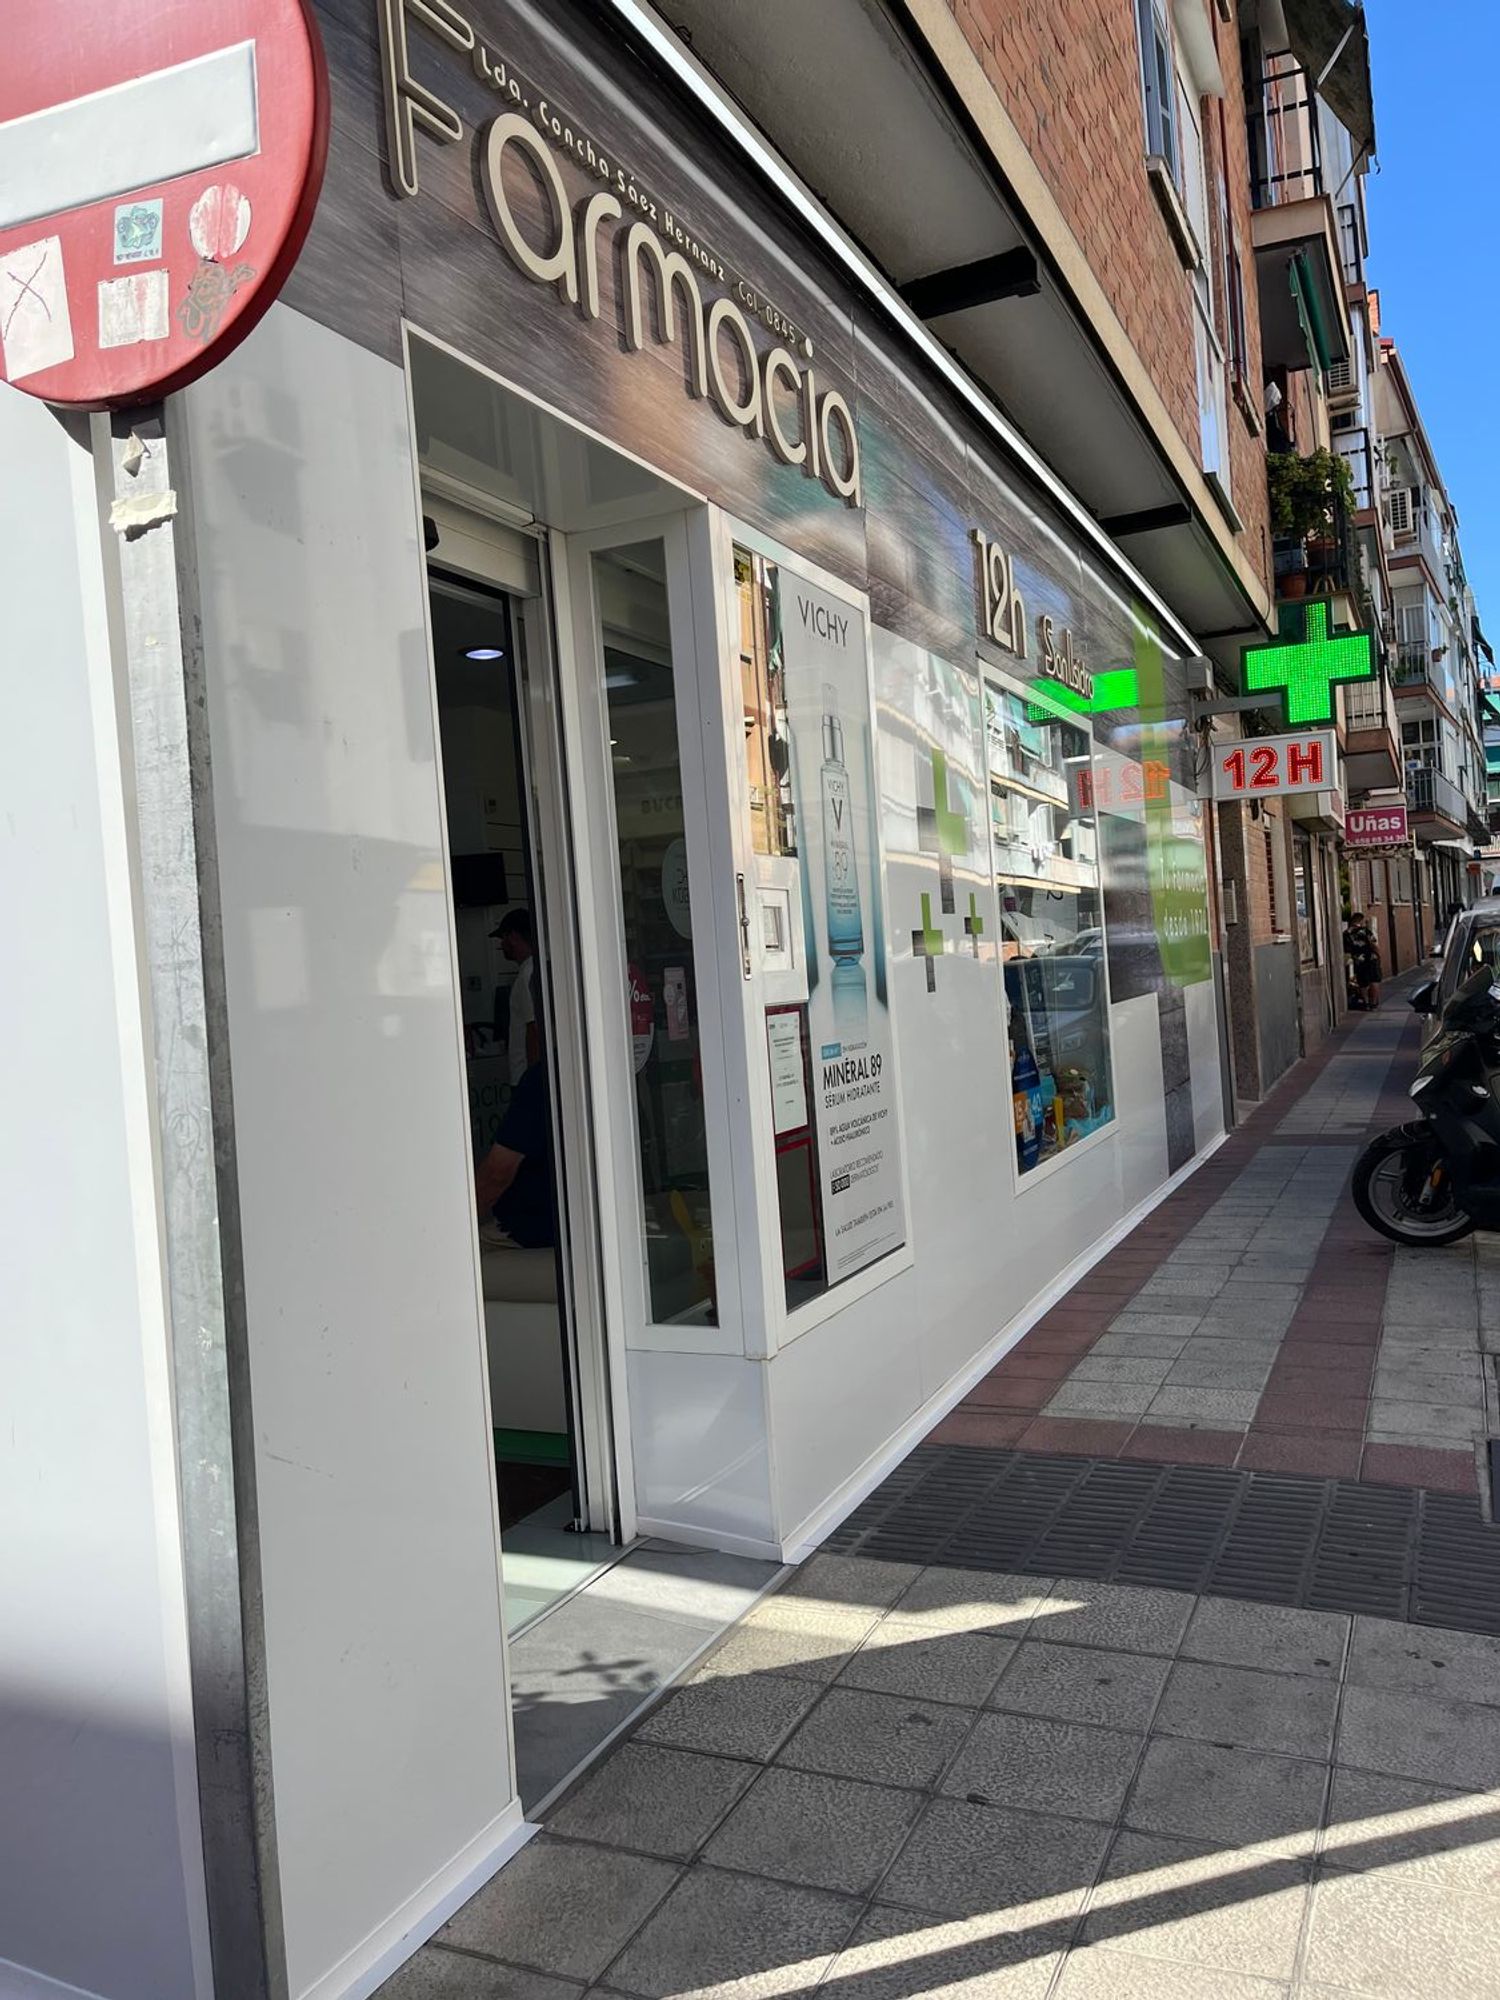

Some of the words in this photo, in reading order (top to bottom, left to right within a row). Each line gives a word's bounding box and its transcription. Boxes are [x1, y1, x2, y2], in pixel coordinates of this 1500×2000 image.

[481, 46, 528, 108] Lda.
[539, 101, 609, 178] Concha
[617, 170, 657, 221] Sáez
[665, 212, 725, 282] Hernanz
[738, 281, 762, 315] Col.
[766, 305, 797, 344] 0845
[380, 0, 862, 508] Farmacia
[797, 595, 848, 647] VICHY
[971, 528, 1029, 660] 12h
[1041, 614, 1068, 685] San
[1223, 747, 1279, 790] 12
[1287, 742, 1323, 785] H
[1350, 815, 1402, 833] Uñas
[823, 1057, 869, 1090] MINÉRAL
[870, 1053, 882, 1077] 89
[825, 1092, 846, 1109] SÉRUM
[847, 1080, 880, 1102] HIDRATANTE
